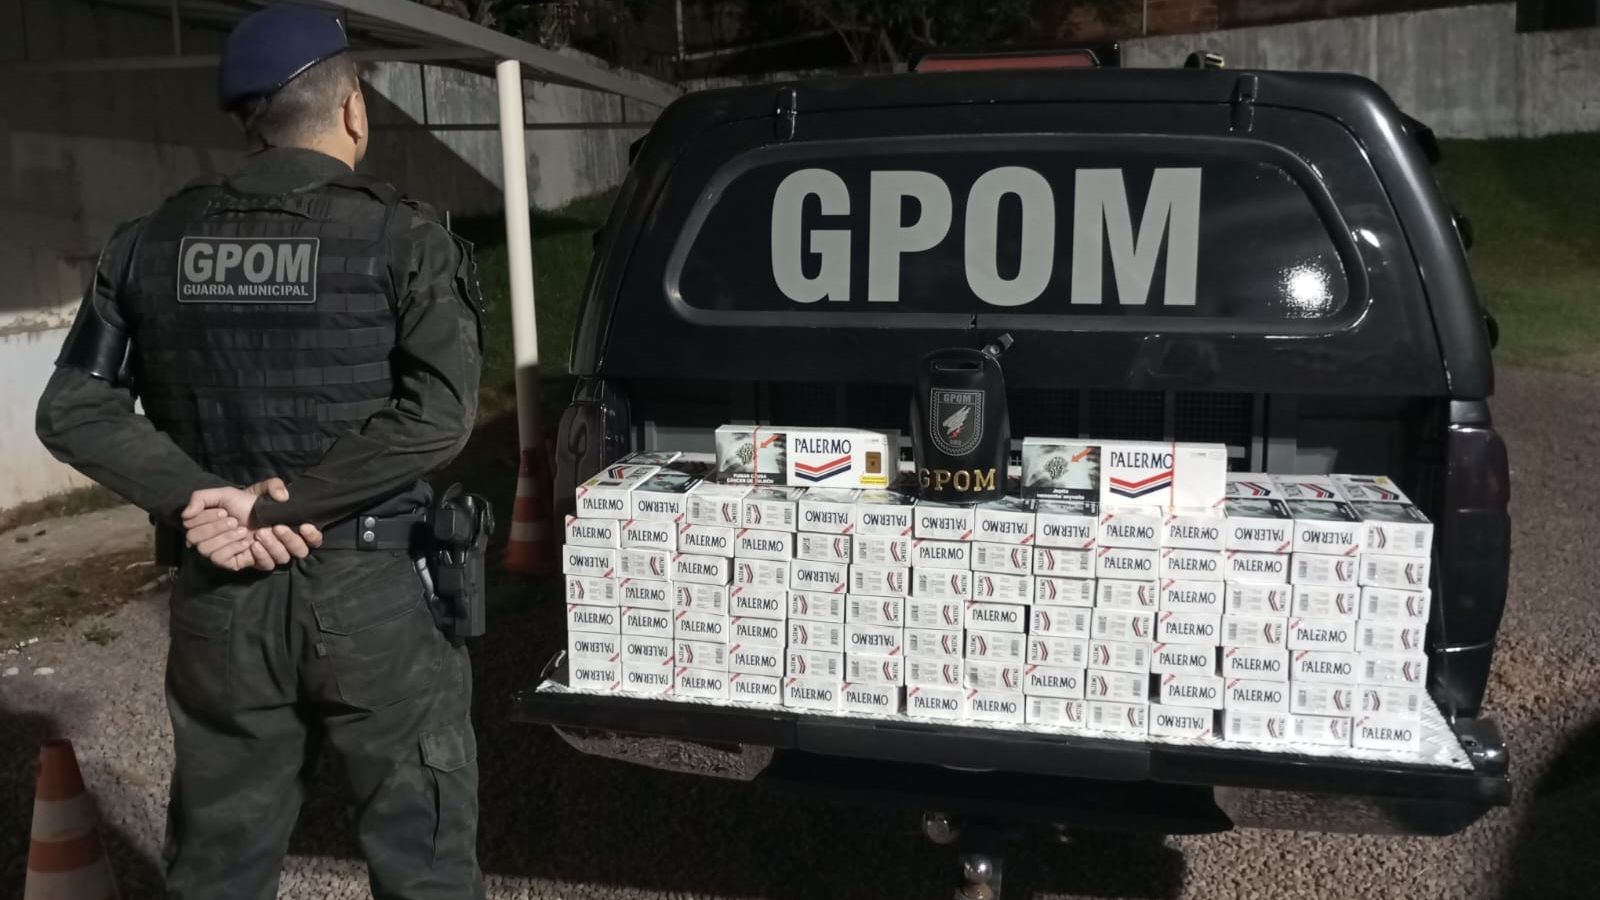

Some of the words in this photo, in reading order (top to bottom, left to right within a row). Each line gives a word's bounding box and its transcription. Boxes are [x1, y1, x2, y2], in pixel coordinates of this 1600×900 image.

[771, 166, 1202, 306] GPOM
[184, 242, 312, 283] GPOM
[184, 284, 234, 296] GUARDA
[238, 284, 308, 296] MUNICIPAL
[944, 394, 971, 403] GPOM
[795, 438, 852, 454] PALERMO
[1110, 451, 1174, 469] PALERMO
[918, 468, 996, 492] GPOM
[583, 497, 624, 510] PALERMO
[638, 500, 679, 513] PALERMO
[806, 510, 848, 524] PALERMO
[863, 513, 906, 526] PALERMO
[922, 517, 966, 530] PALERMO
[572, 526, 612, 539] PALERMO
[982, 520, 1028, 534] PALERMO
[1043, 524, 1089, 538] PALERMO
[1106, 526, 1153, 538] PALERMO
[1170, 526, 1218, 540] PALERMO
[628, 530, 668, 542] PALERMO
[1235, 527, 1283, 541] PALERMO
[1302, 530, 1353, 544] PALERMO
[686, 534, 726, 548] PALERMO
[742, 537, 784, 552] PALERMO
[920, 547, 963, 560] PALERMO
[570, 556, 608, 568] PALERMO
[1104, 557, 1151, 570] PALERMO
[1168, 557, 1216, 571] PALERMO
[1233, 559, 1282, 572] PALERMO
[678, 562, 718, 576] PALERMO
[798, 569, 840, 584] PALERMO
[625, 587, 665, 600] PALERMO
[1168, 591, 1216, 604] PALERMO
[737, 596, 778, 610] PALERMO
[574, 611, 613, 624] PALERMO
[628, 616, 668, 628] PALERMO
[972, 609, 1017, 622] PALERMO
[681, 621, 721, 633] PALERMO
[737, 625, 778, 638] PALERMO
[1166, 623, 1213, 636] PALERMO
[852, 633, 894, 646] PALERMO
[1297, 627, 1347, 643] PALERMO
[575, 641, 614, 653] PALERMO
[627, 643, 668, 657] PALERMO
[735, 653, 776, 667] PALERMO
[1159, 653, 1206, 667] PALERMO
[1232, 658, 1280, 672] PALERMO
[1302, 661, 1351, 675] PALERMO
[576, 669, 614, 682] PALERMO
[629, 672, 668, 685] PALERMO
[681, 677, 721, 689] PALERMO
[736, 682, 776, 695] PALERMO
[1031, 676, 1076, 689] PALERMO
[791, 688, 832, 701] PALERMO
[846, 691, 888, 705] PALERMO
[1169, 685, 1216, 699] PALERMO
[1233, 689, 1281, 703] PALERMO
[914, 696, 958, 710] PALERMO
[973, 700, 1016, 713] PALERMO
[1157, 716, 1204, 729] PALERMO
[1362, 729, 1412, 741] PALERMO
